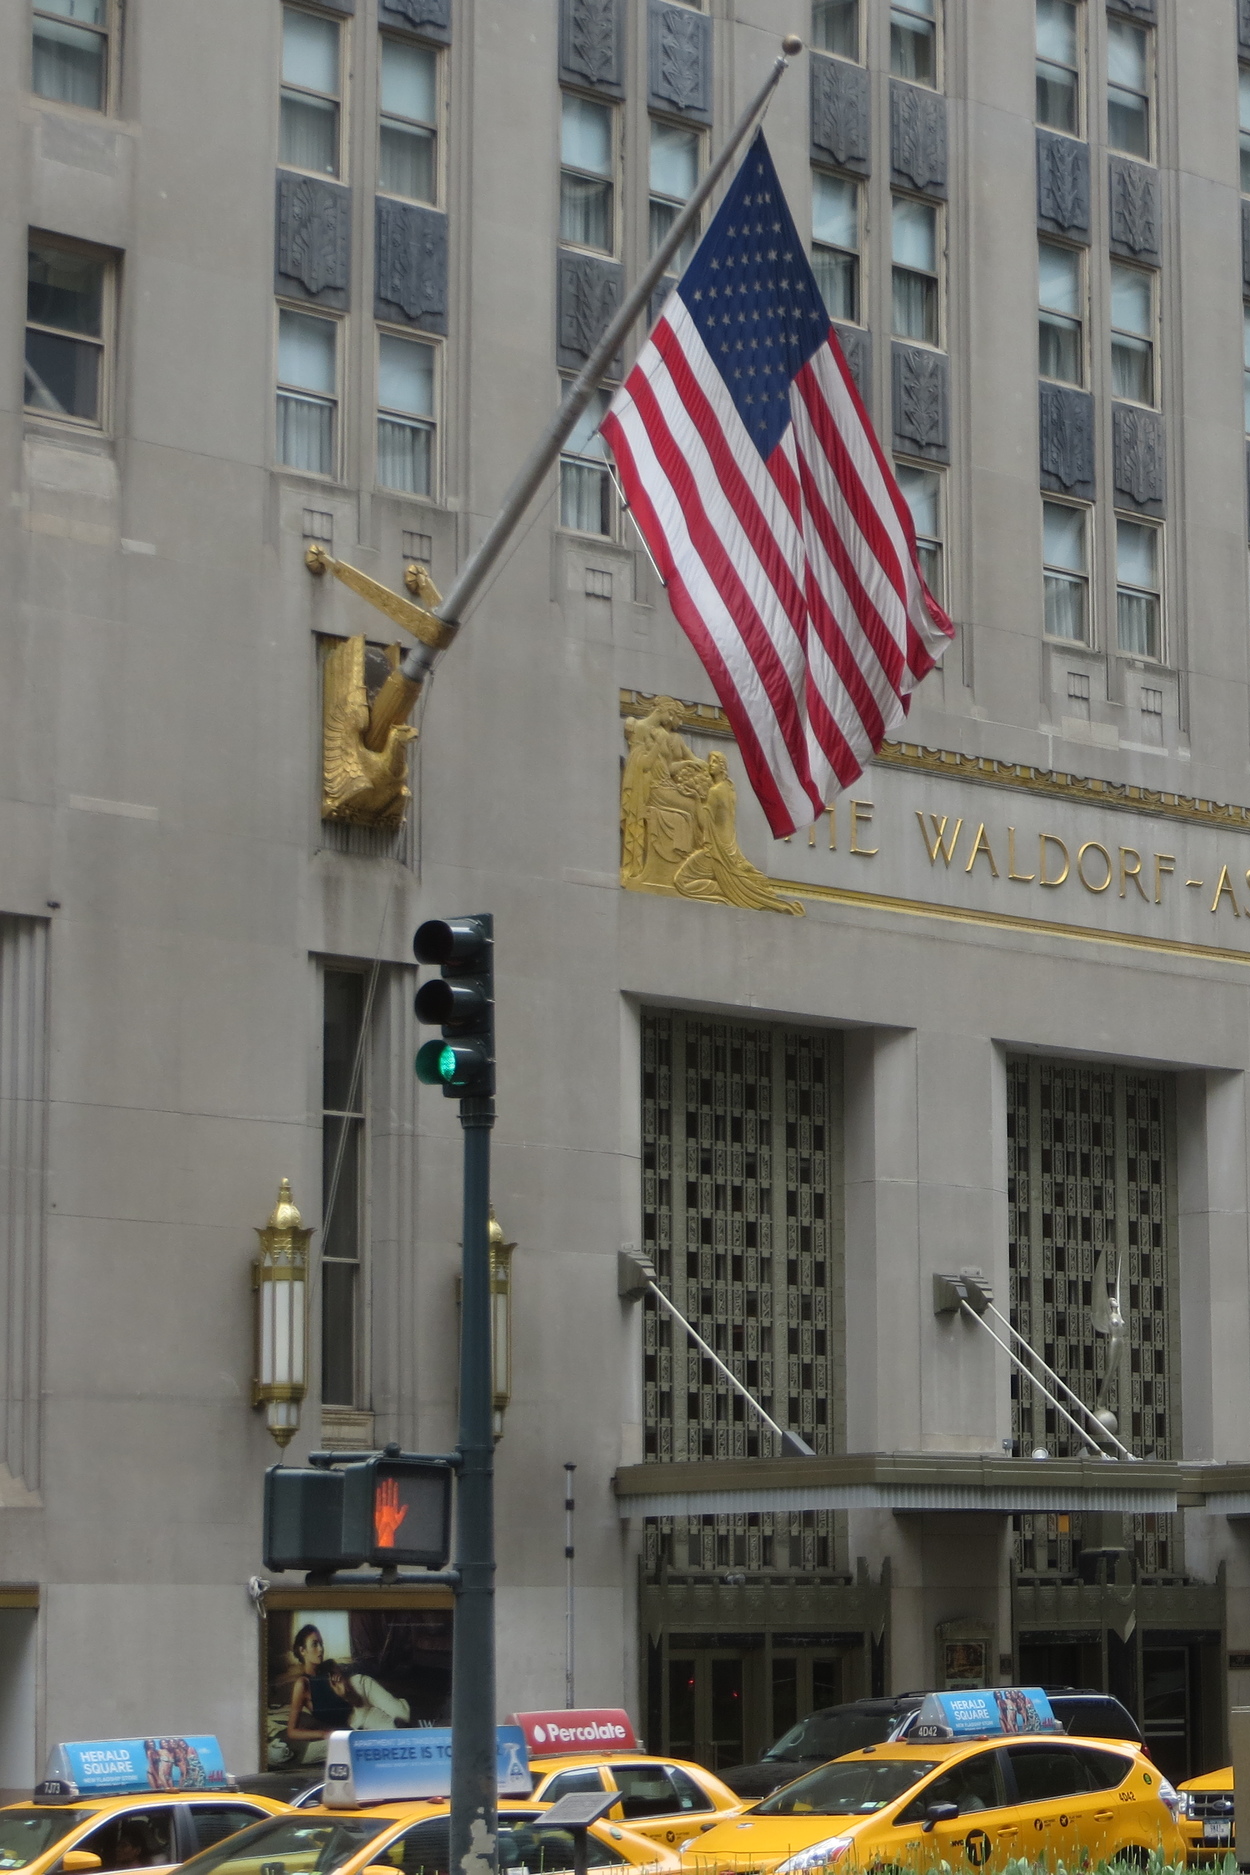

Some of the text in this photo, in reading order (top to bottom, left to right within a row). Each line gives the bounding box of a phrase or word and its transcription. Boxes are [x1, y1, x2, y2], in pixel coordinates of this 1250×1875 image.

[783, 799, 880, 857] HE
[950, 1699, 986, 1710] HERALD
[954, 1710, 990, 1720] SQUARE
[546, 1721, 626, 1742] Percolate
[918, 1726, 938, 1737] 4D42
[79, 1749, 130, 1762] HERALD
[355, 1747, 417, 1761] FEBREZE
[421, 1746, 432, 1759] IS
[83, 1761, 134, 1775] SQUARE
[44, 1783, 60, 1794] 7J73
[1118, 1791, 1136, 1802] 4D42
